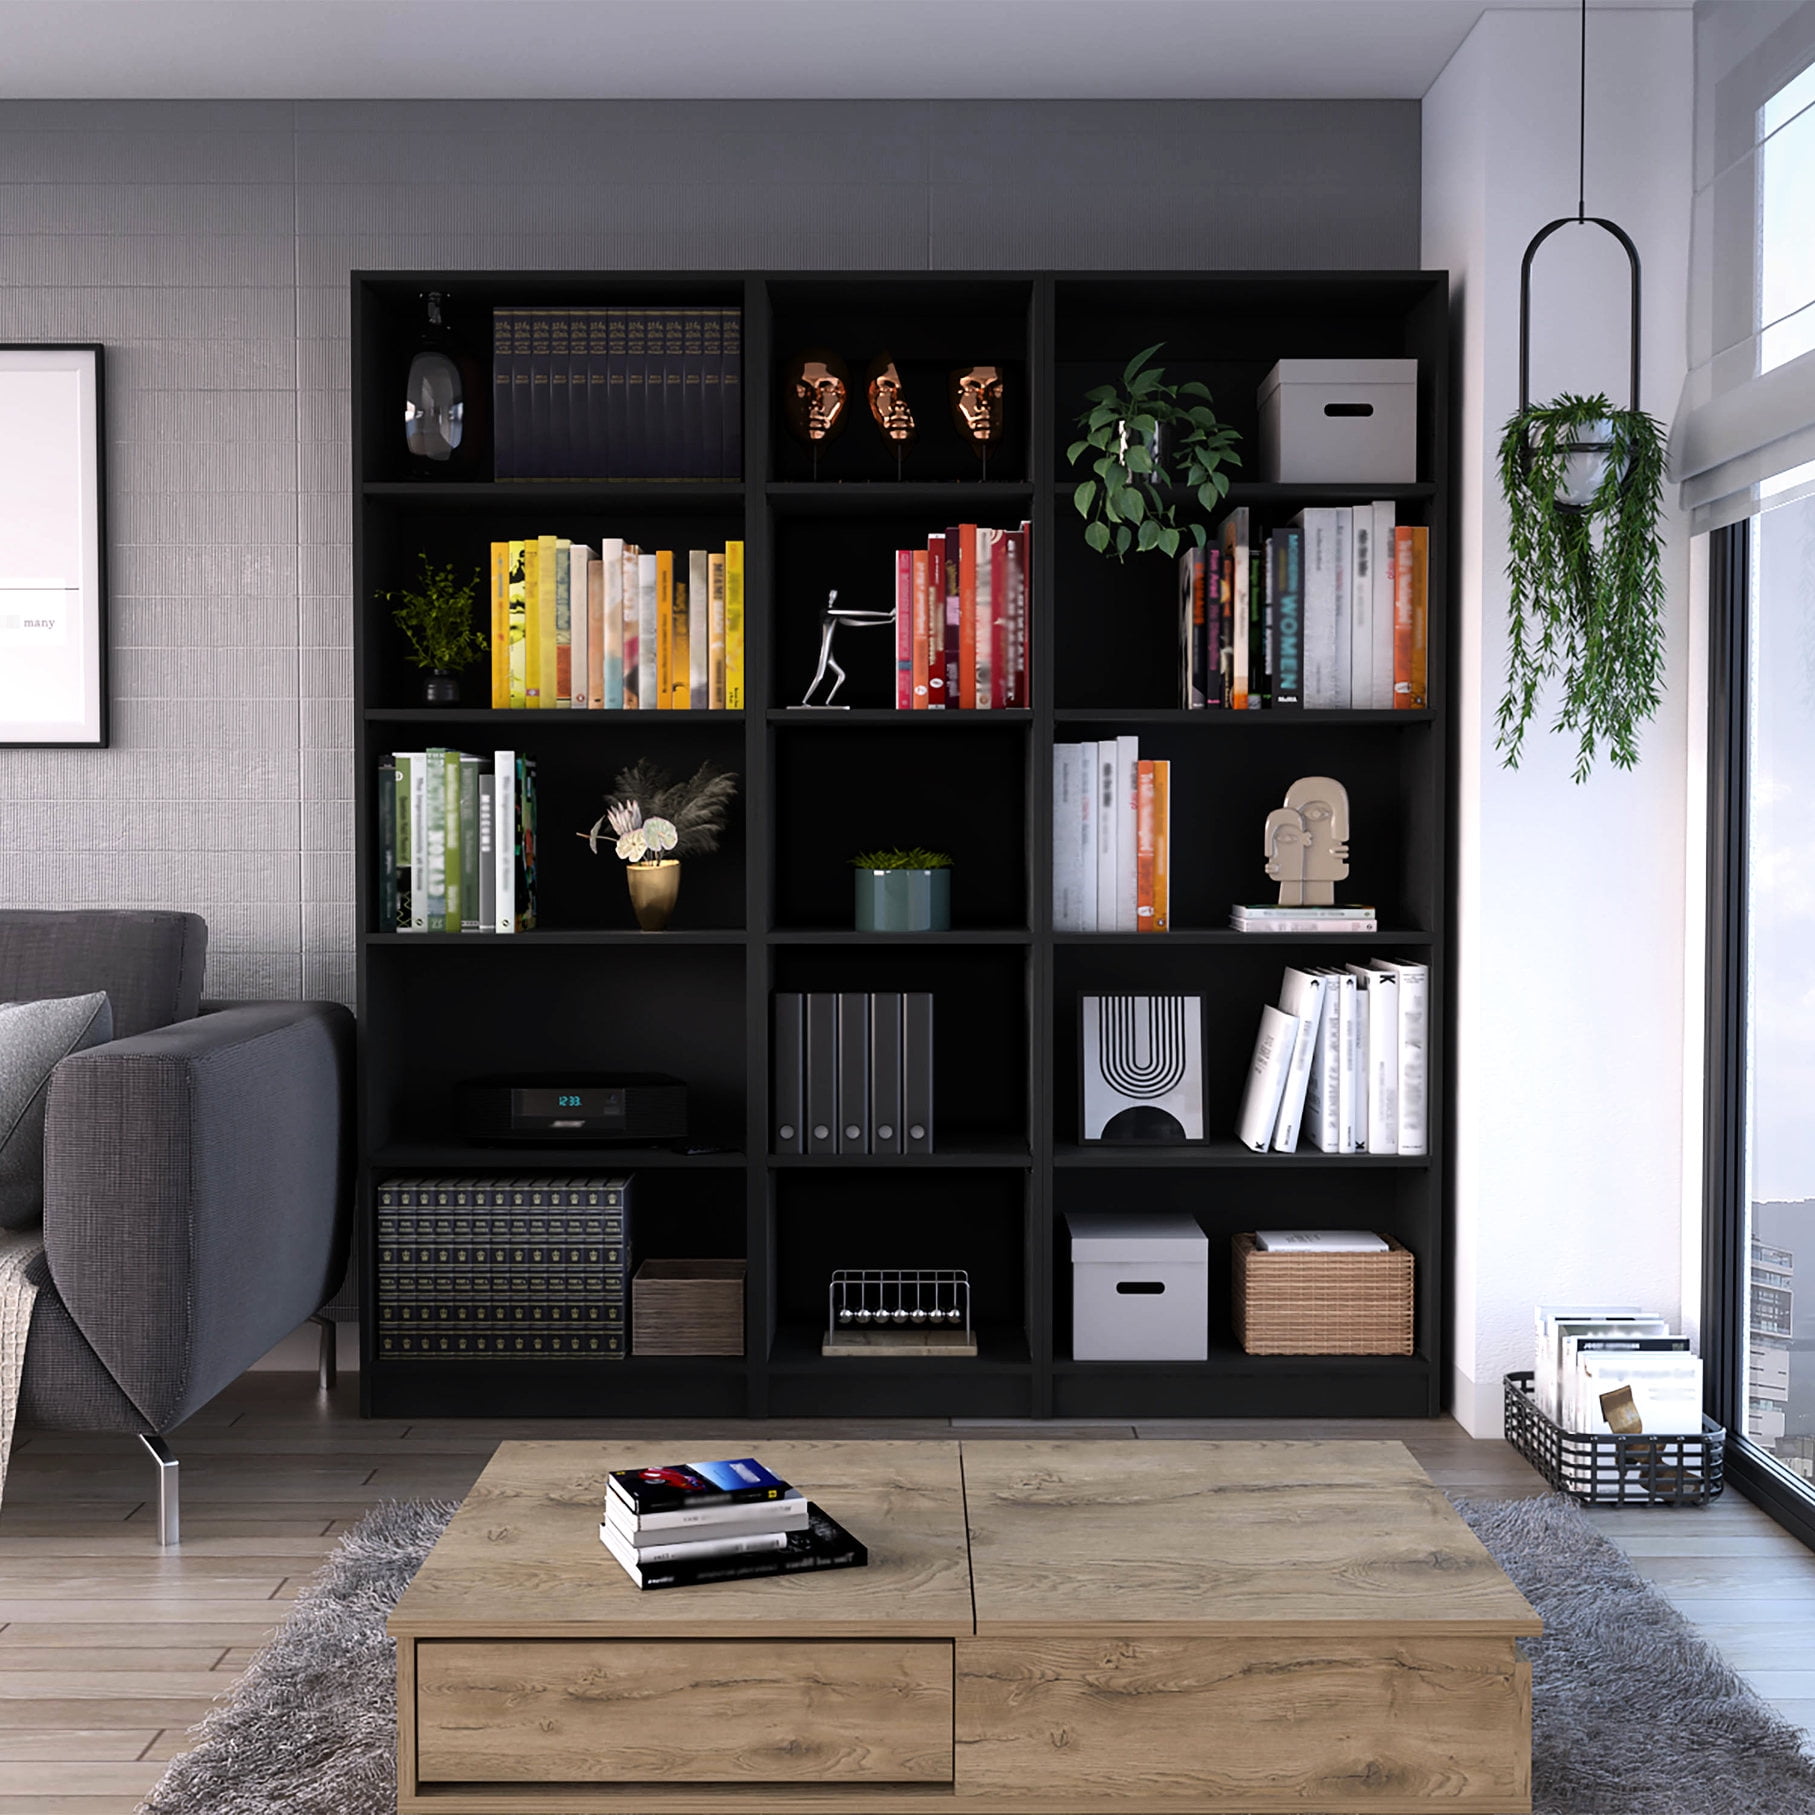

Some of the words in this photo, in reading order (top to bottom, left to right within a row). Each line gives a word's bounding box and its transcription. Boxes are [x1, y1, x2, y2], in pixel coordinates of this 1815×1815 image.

[23, 619, 56, 630] many
[1279, 595, 1299, 690] WOMEN
[427, 830, 445, 896] NOMAD
[1379, 974, 1396, 984] K
